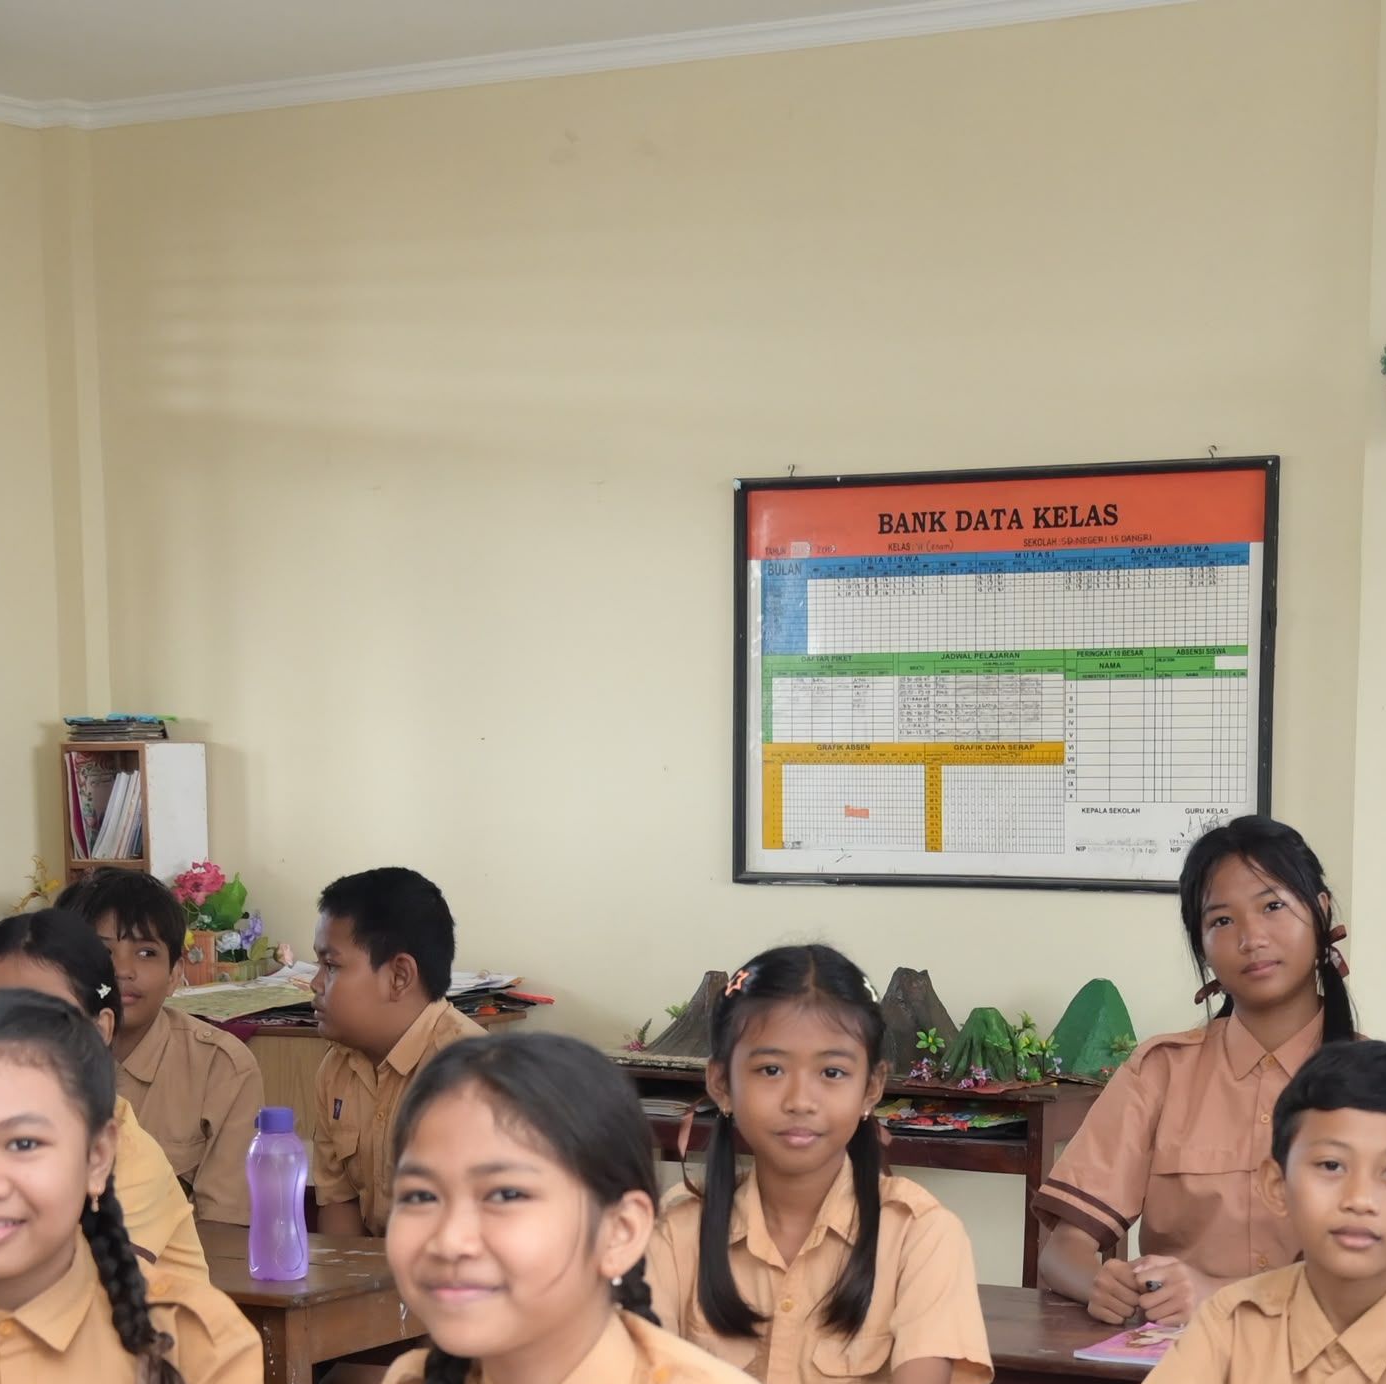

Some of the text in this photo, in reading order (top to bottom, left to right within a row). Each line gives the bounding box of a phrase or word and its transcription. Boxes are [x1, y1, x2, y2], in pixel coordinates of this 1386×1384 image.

[878, 504, 1119, 534] BANK DATA KELAS
[888, 543, 910, 551] KELAS
[1024, 538, 1057, 547] SEKOLAH
[1175, 545, 1210, 553] SISWA
[768, 562, 802, 576] BULAN
[1076, 650, 1112, 658] PERINGKAT
[1122, 649, 1144, 657] BESAR
